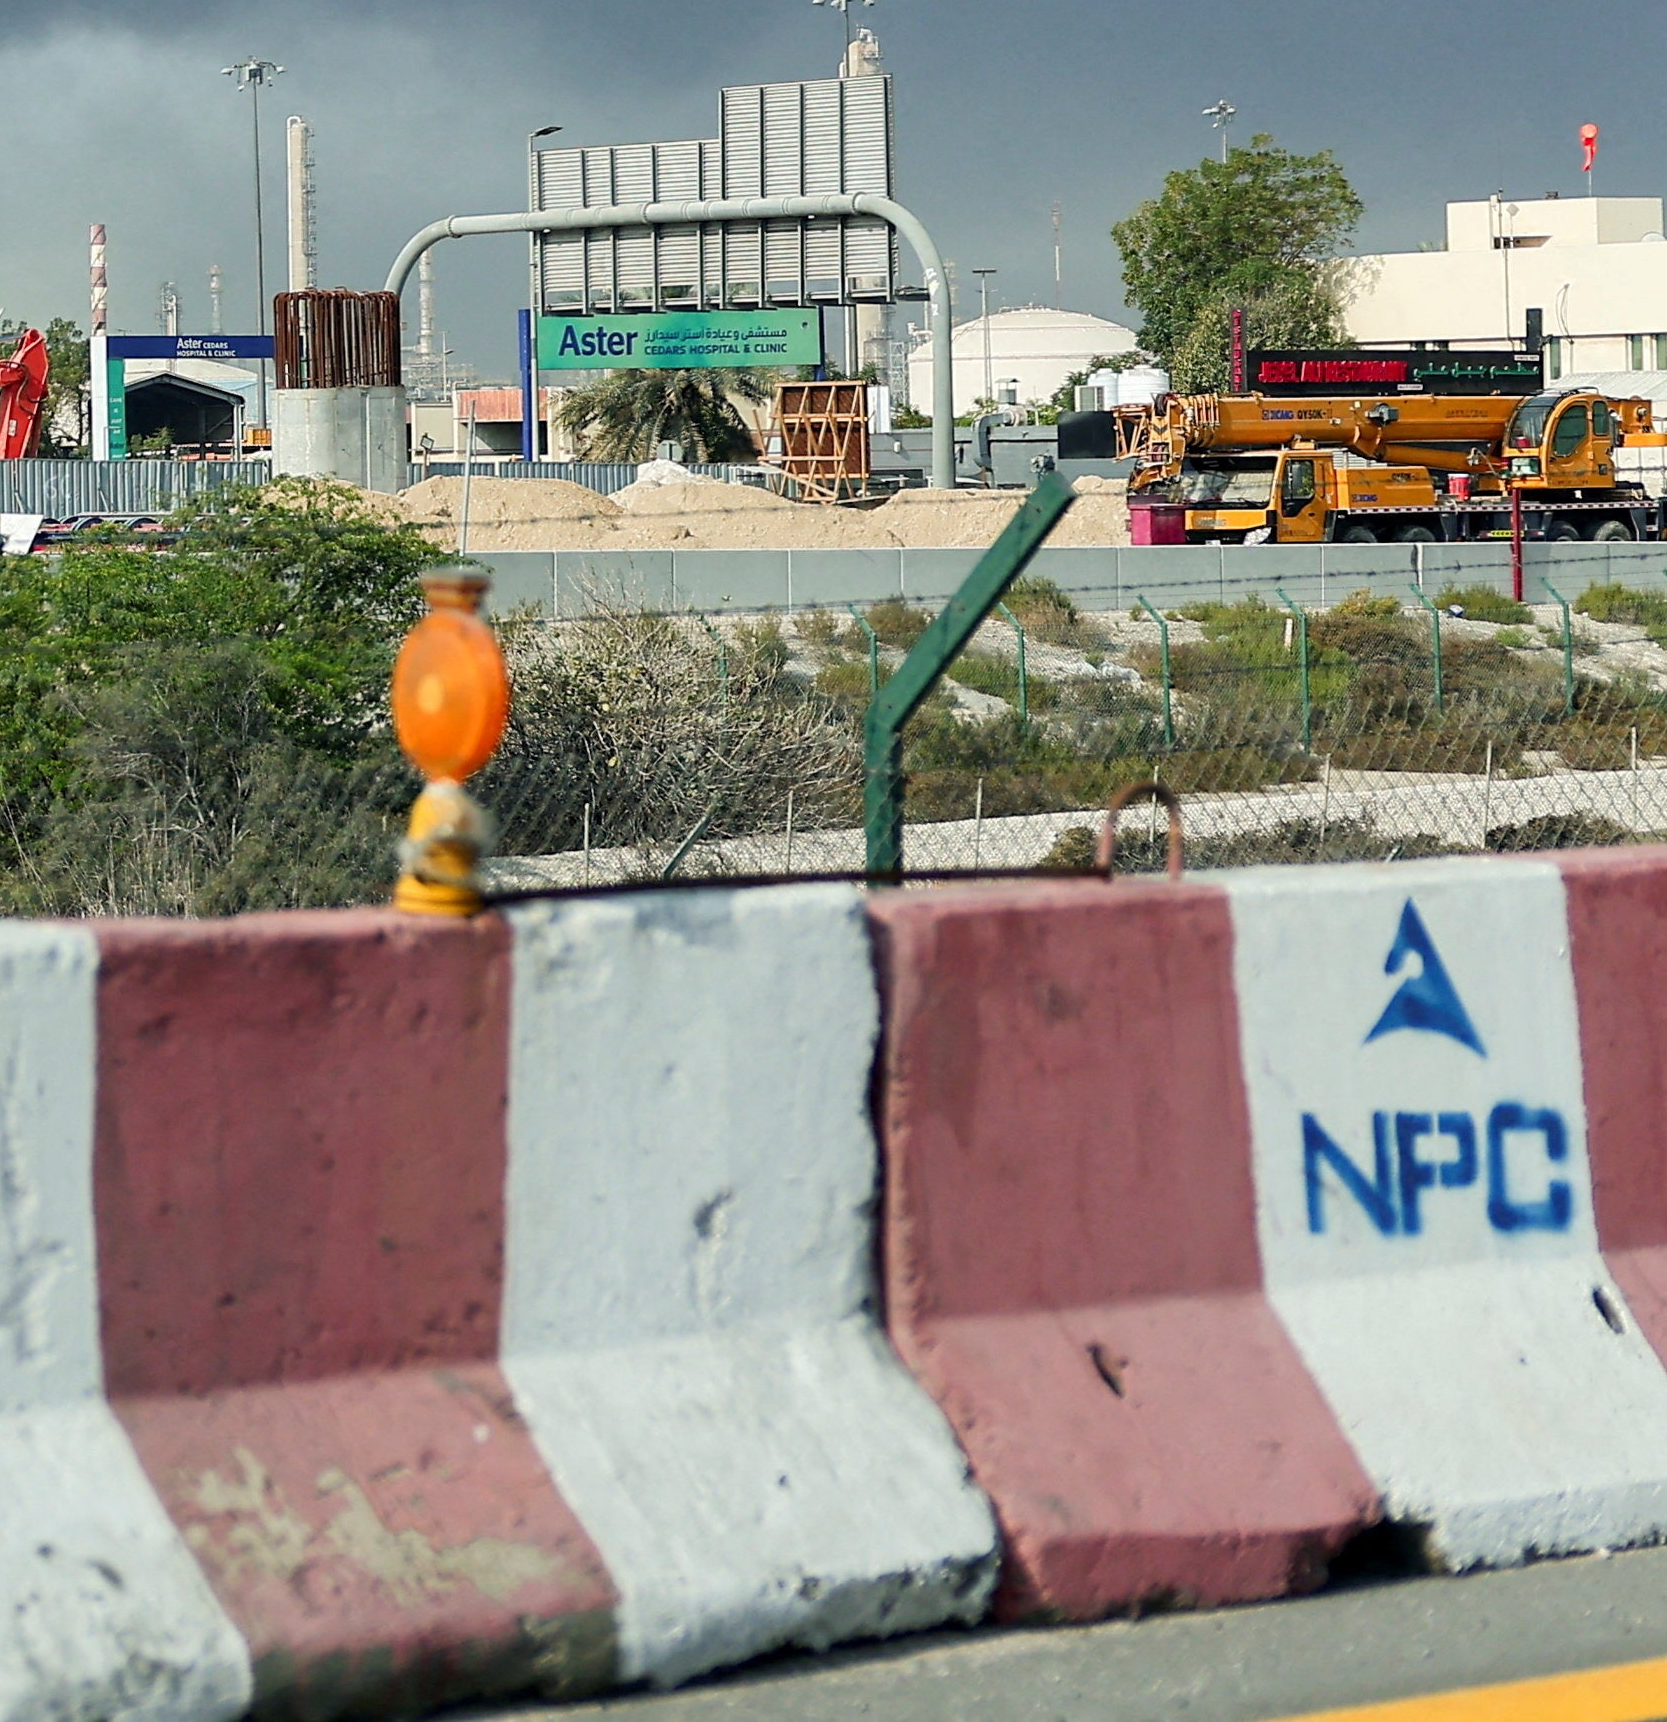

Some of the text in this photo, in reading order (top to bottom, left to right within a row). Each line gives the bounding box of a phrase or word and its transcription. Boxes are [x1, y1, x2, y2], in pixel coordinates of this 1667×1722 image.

[558, 325, 638, 356] Aster
[741, 325, 788, 341] مستشفى
[177, 338, 202, 349] Aster
[645, 343, 788, 355] CEDARS HOSPITAL & CLINIC
[1301, 1101, 1574, 1236] NPC
